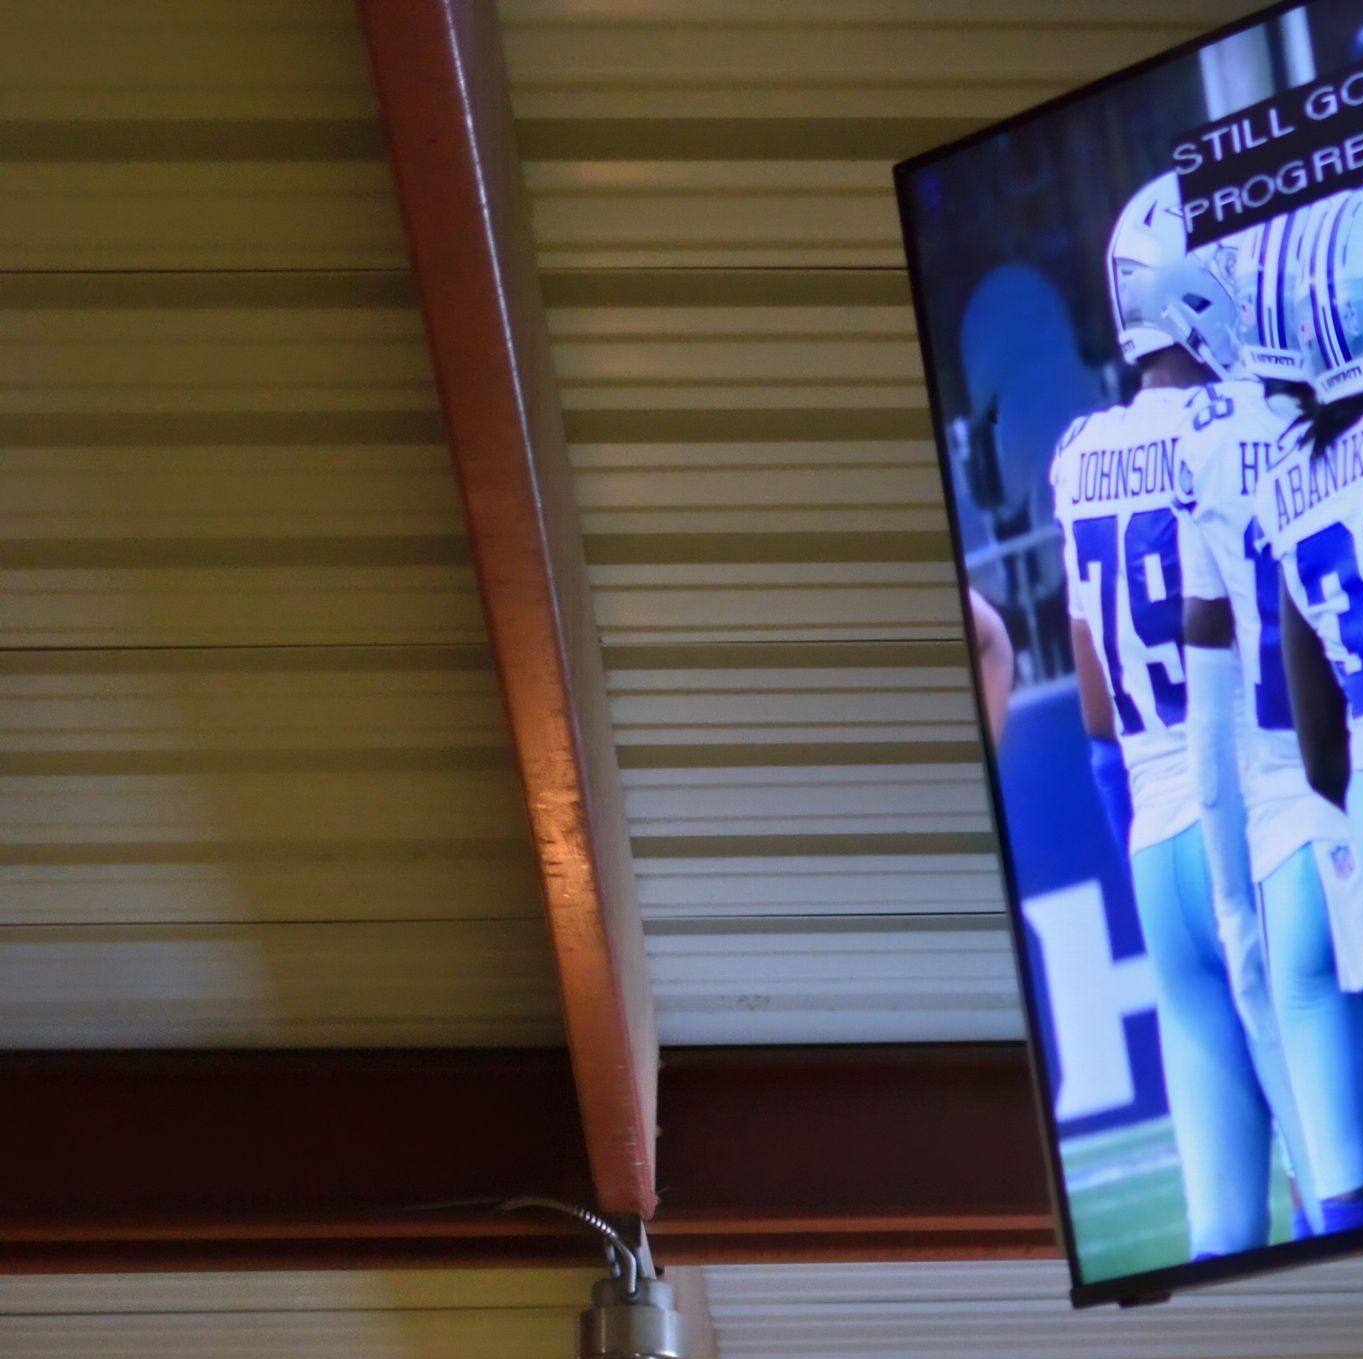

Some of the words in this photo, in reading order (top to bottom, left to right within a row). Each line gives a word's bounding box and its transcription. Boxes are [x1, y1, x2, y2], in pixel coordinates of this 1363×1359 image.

[1172, 106, 1297, 176] STILL
[1072, 436, 1182, 504] JOHNSON
[1072, 506, 1188, 738] 79
